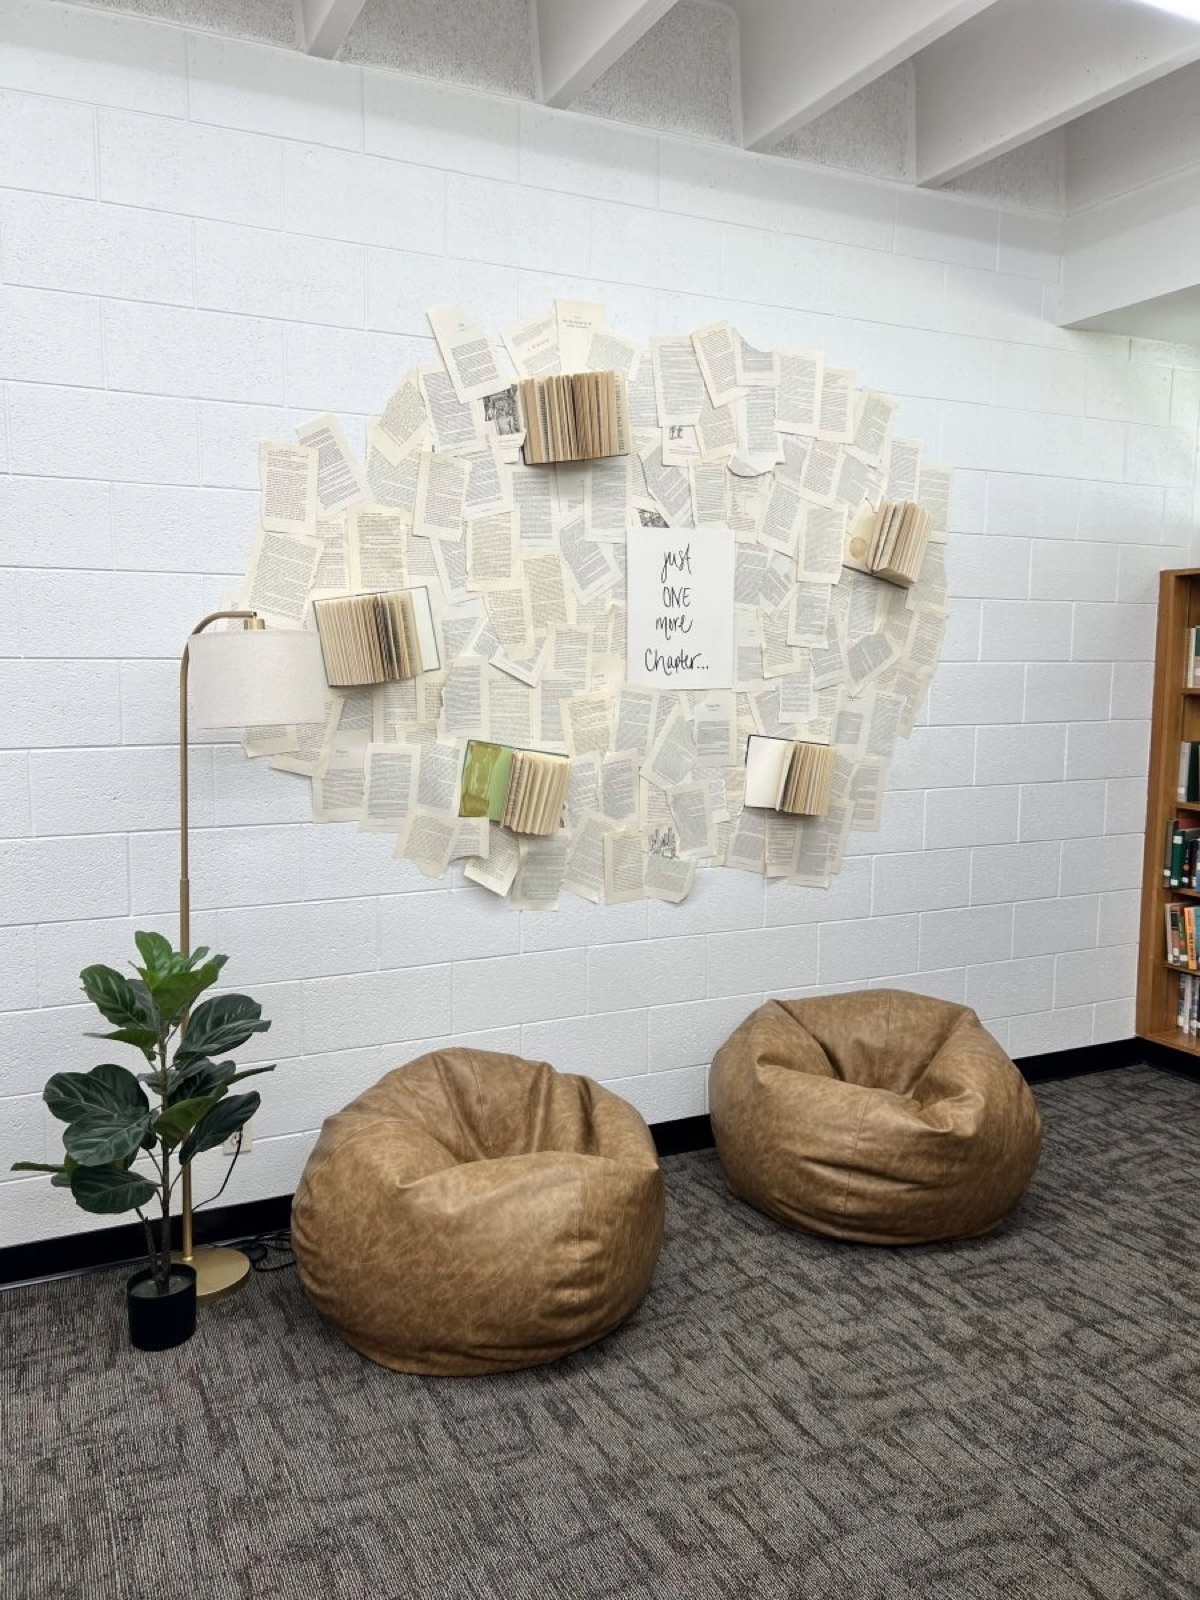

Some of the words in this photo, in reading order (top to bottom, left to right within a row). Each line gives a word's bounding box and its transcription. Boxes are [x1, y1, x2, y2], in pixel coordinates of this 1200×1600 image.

[660, 543, 692, 583] just
[663, 586, 691, 608] ONE
[655, 614, 693, 640] more
